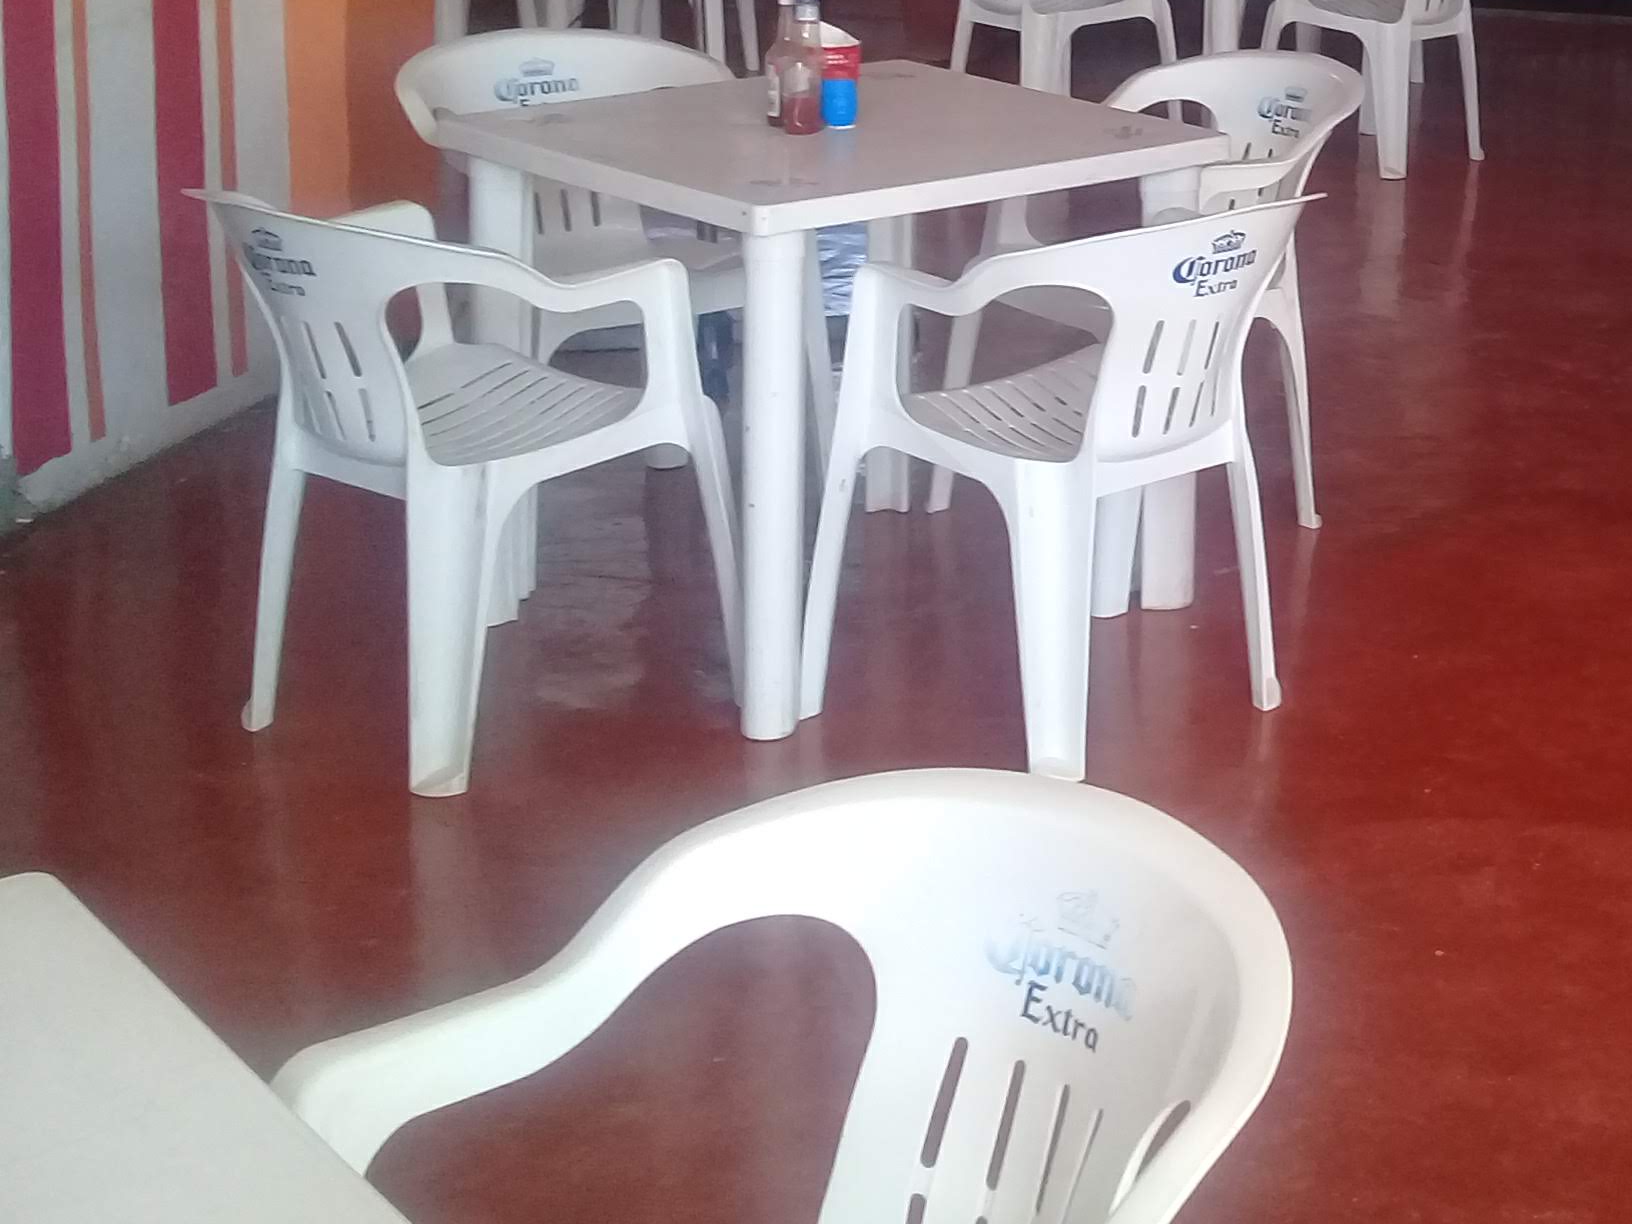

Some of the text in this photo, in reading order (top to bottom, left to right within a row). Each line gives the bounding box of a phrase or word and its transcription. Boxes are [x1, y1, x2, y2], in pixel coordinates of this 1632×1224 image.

[495, 78, 580, 104] Corona
[1172, 249, 1257, 286] Corona
[1194, 279, 1238, 297] Extra
[983, 919, 1137, 1022] Corona
[1020, 979, 1099, 1053] Extra
